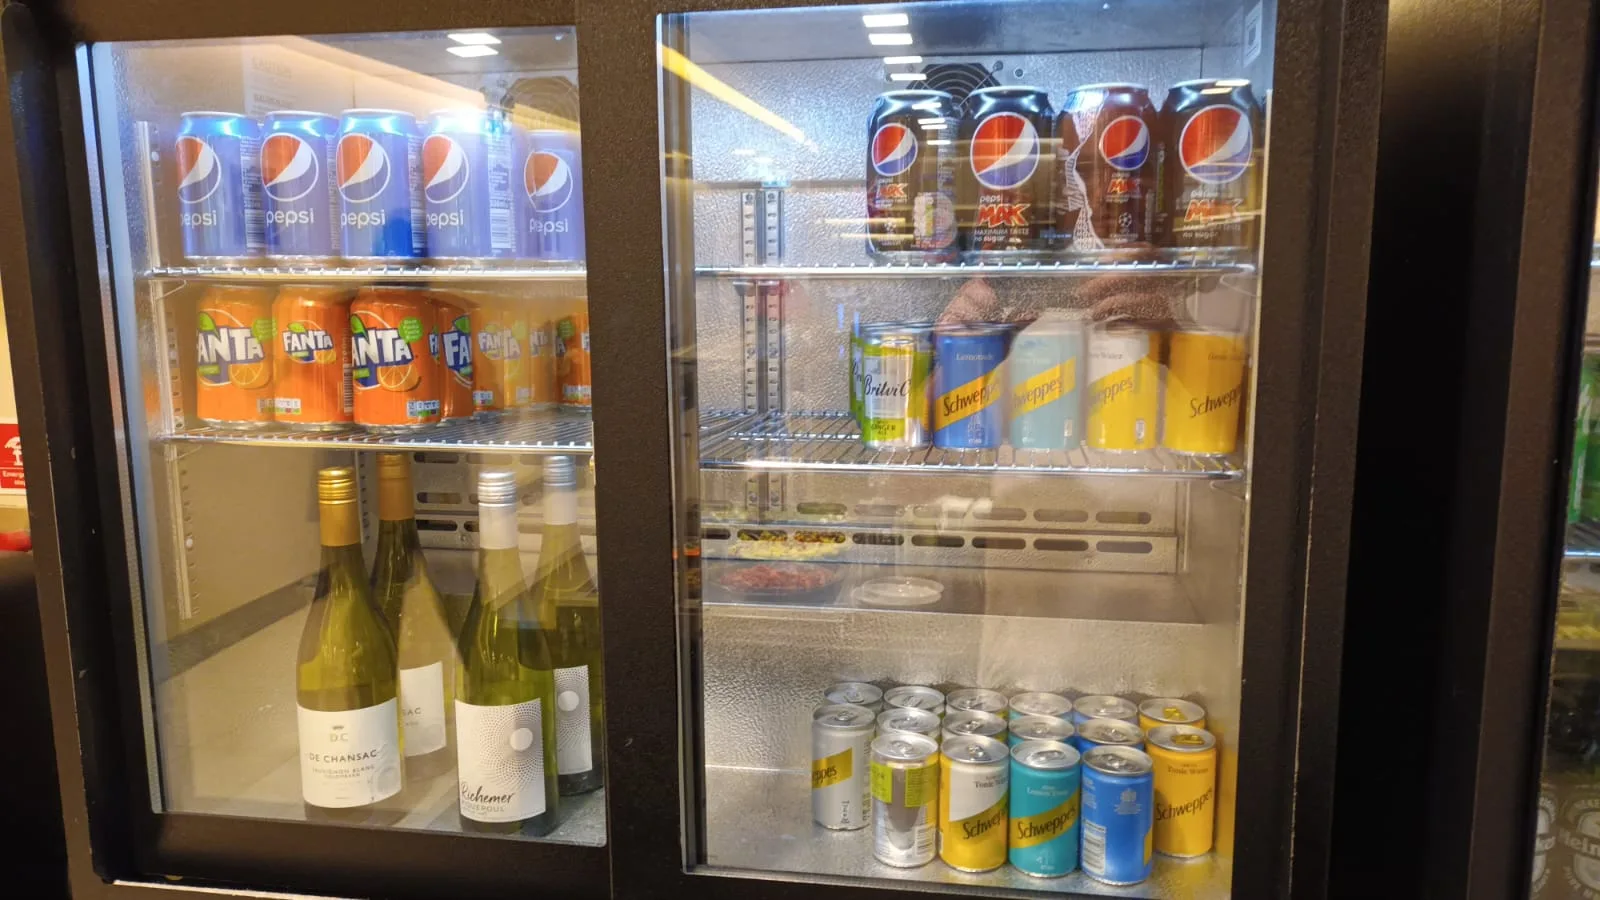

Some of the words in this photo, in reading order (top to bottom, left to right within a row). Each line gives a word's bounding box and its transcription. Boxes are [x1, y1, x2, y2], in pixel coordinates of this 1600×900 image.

[265, 207, 315, 228] pepsi
[340, 208, 386, 229] pepsi
[529, 217, 569, 236] pepsi
[977, 203, 1031, 228] MAX
[197, 327, 264, 363] ANTA
[282, 329, 333, 352] FANTA
[323, 749, 378, 764] CHANSAC
[461, 780, 516, 804] Richemer
